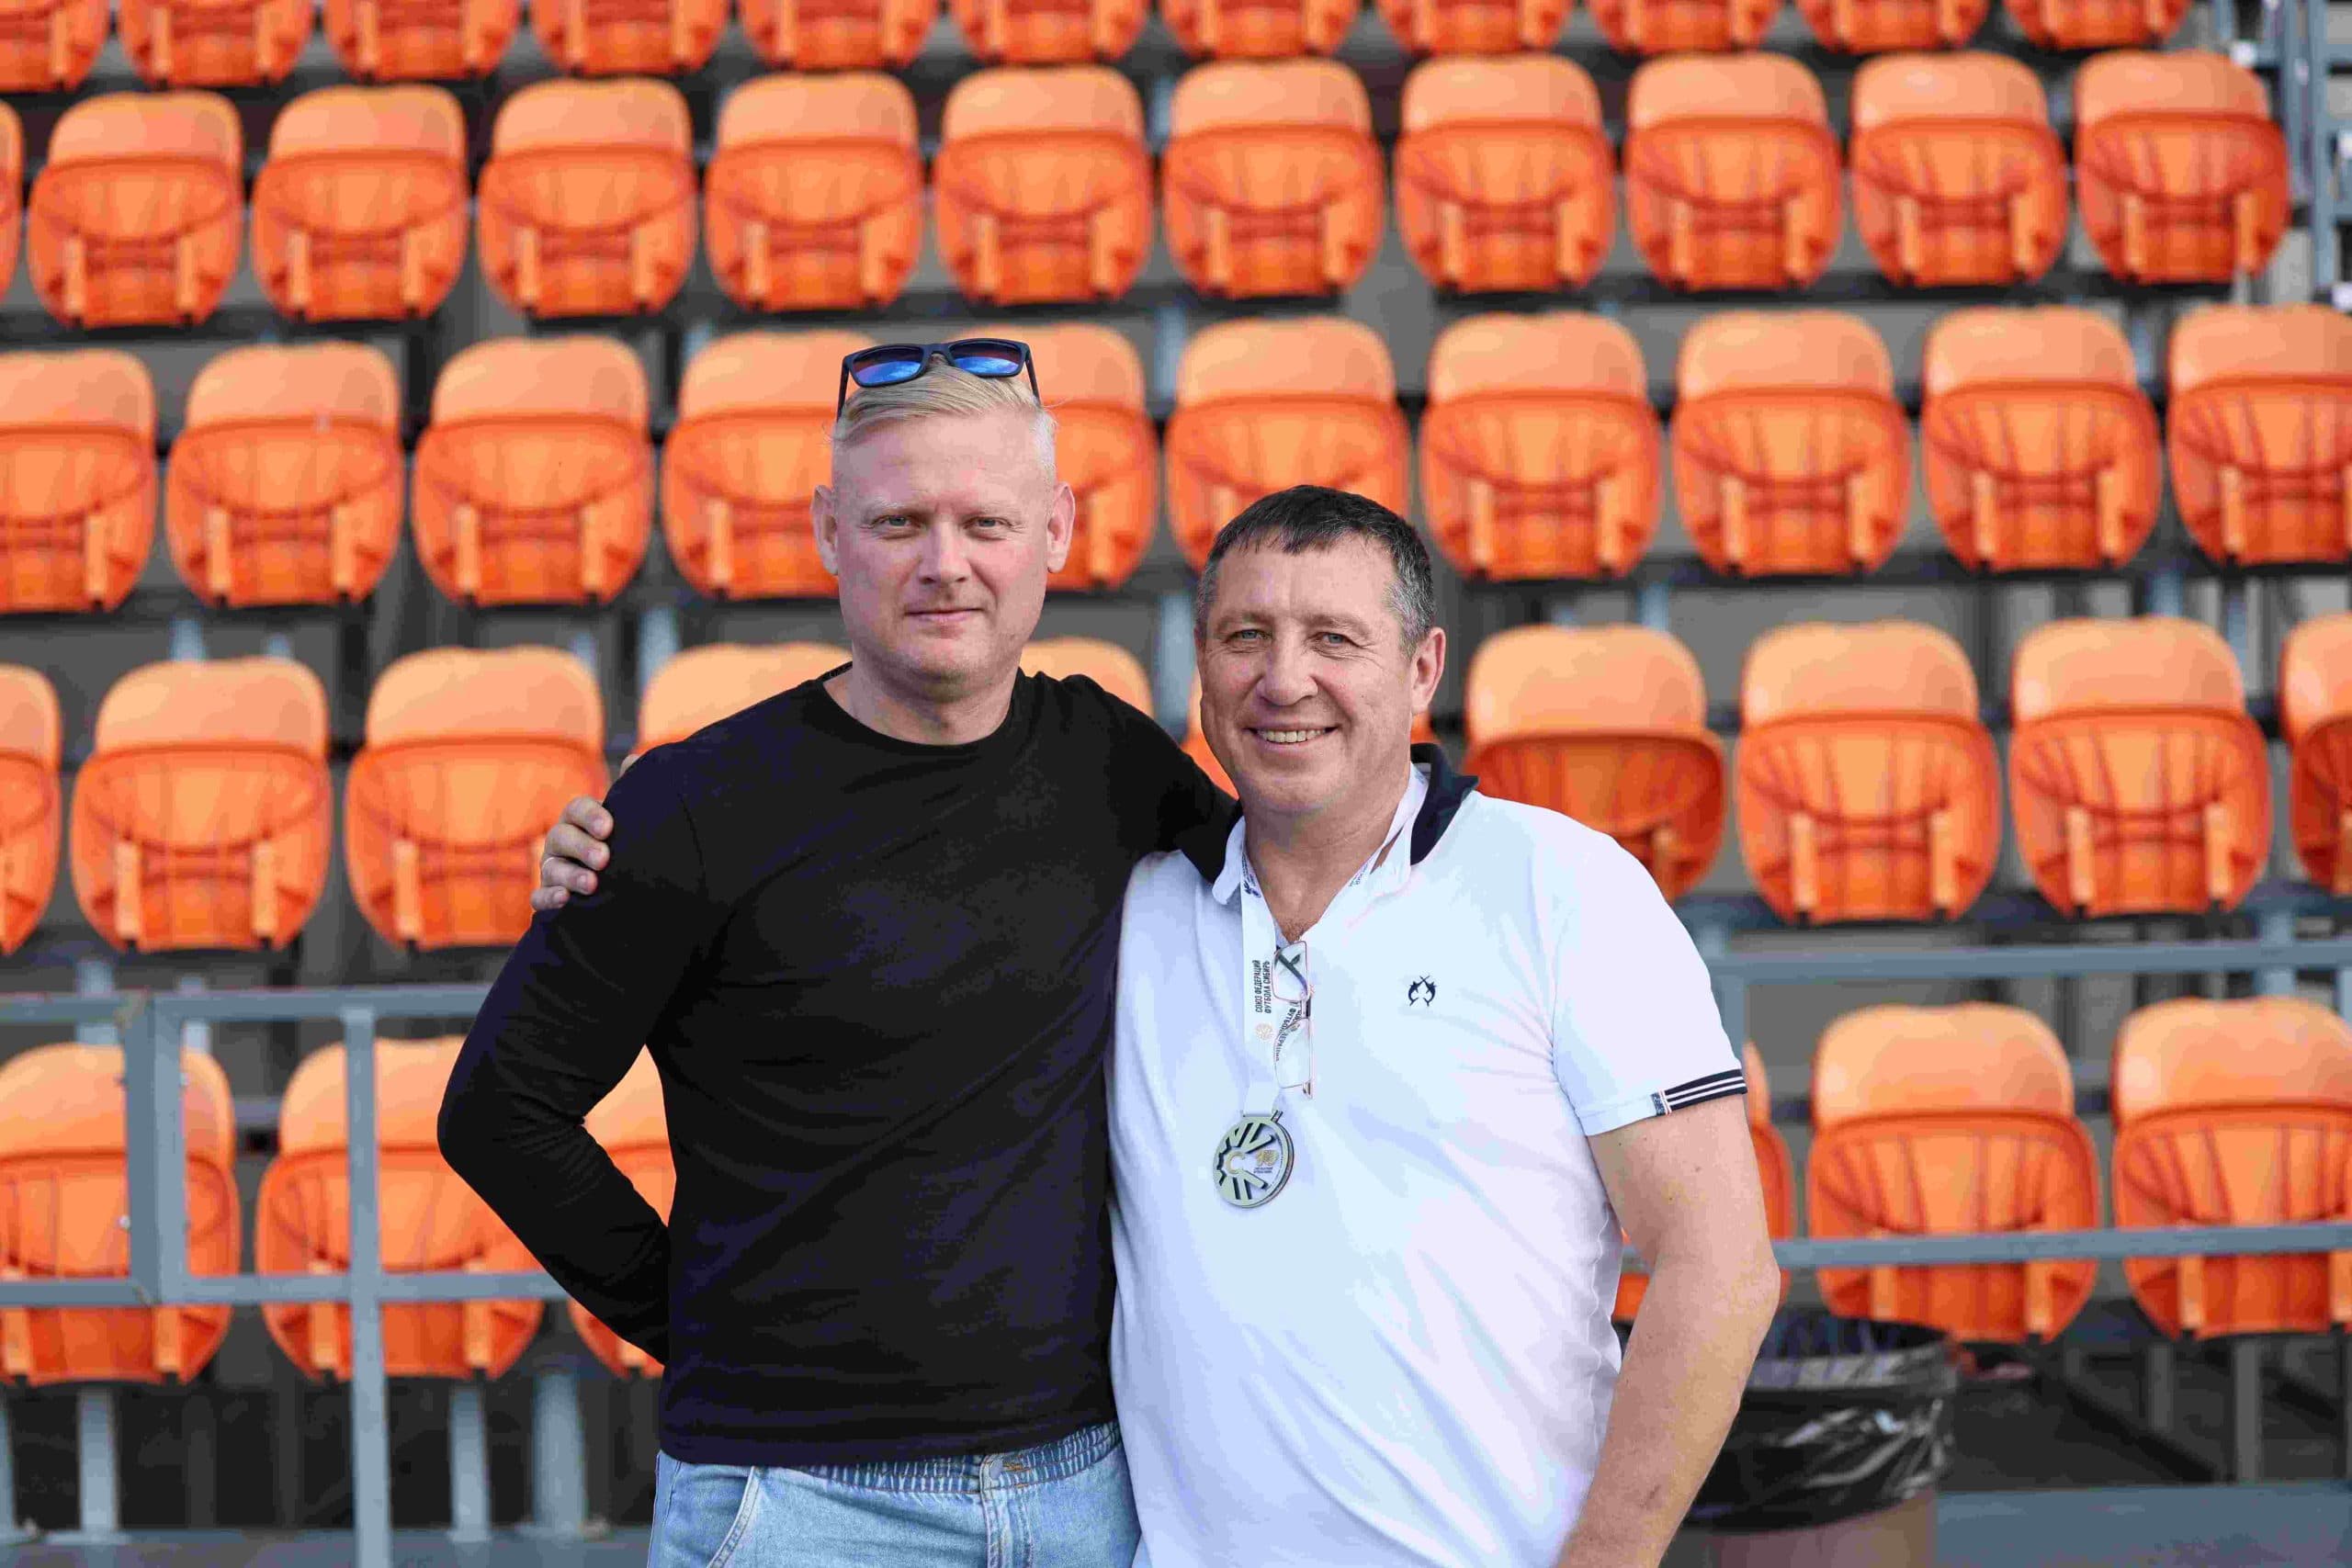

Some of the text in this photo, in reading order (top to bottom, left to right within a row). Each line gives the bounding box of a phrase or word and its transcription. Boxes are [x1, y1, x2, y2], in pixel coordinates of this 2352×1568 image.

[1252, 960, 1263, 1013] СОЮЗ ФЕДЕРАЦИЙ
[1262, 961, 1272, 1014] ФУТБОЛА СИБИРЬ
